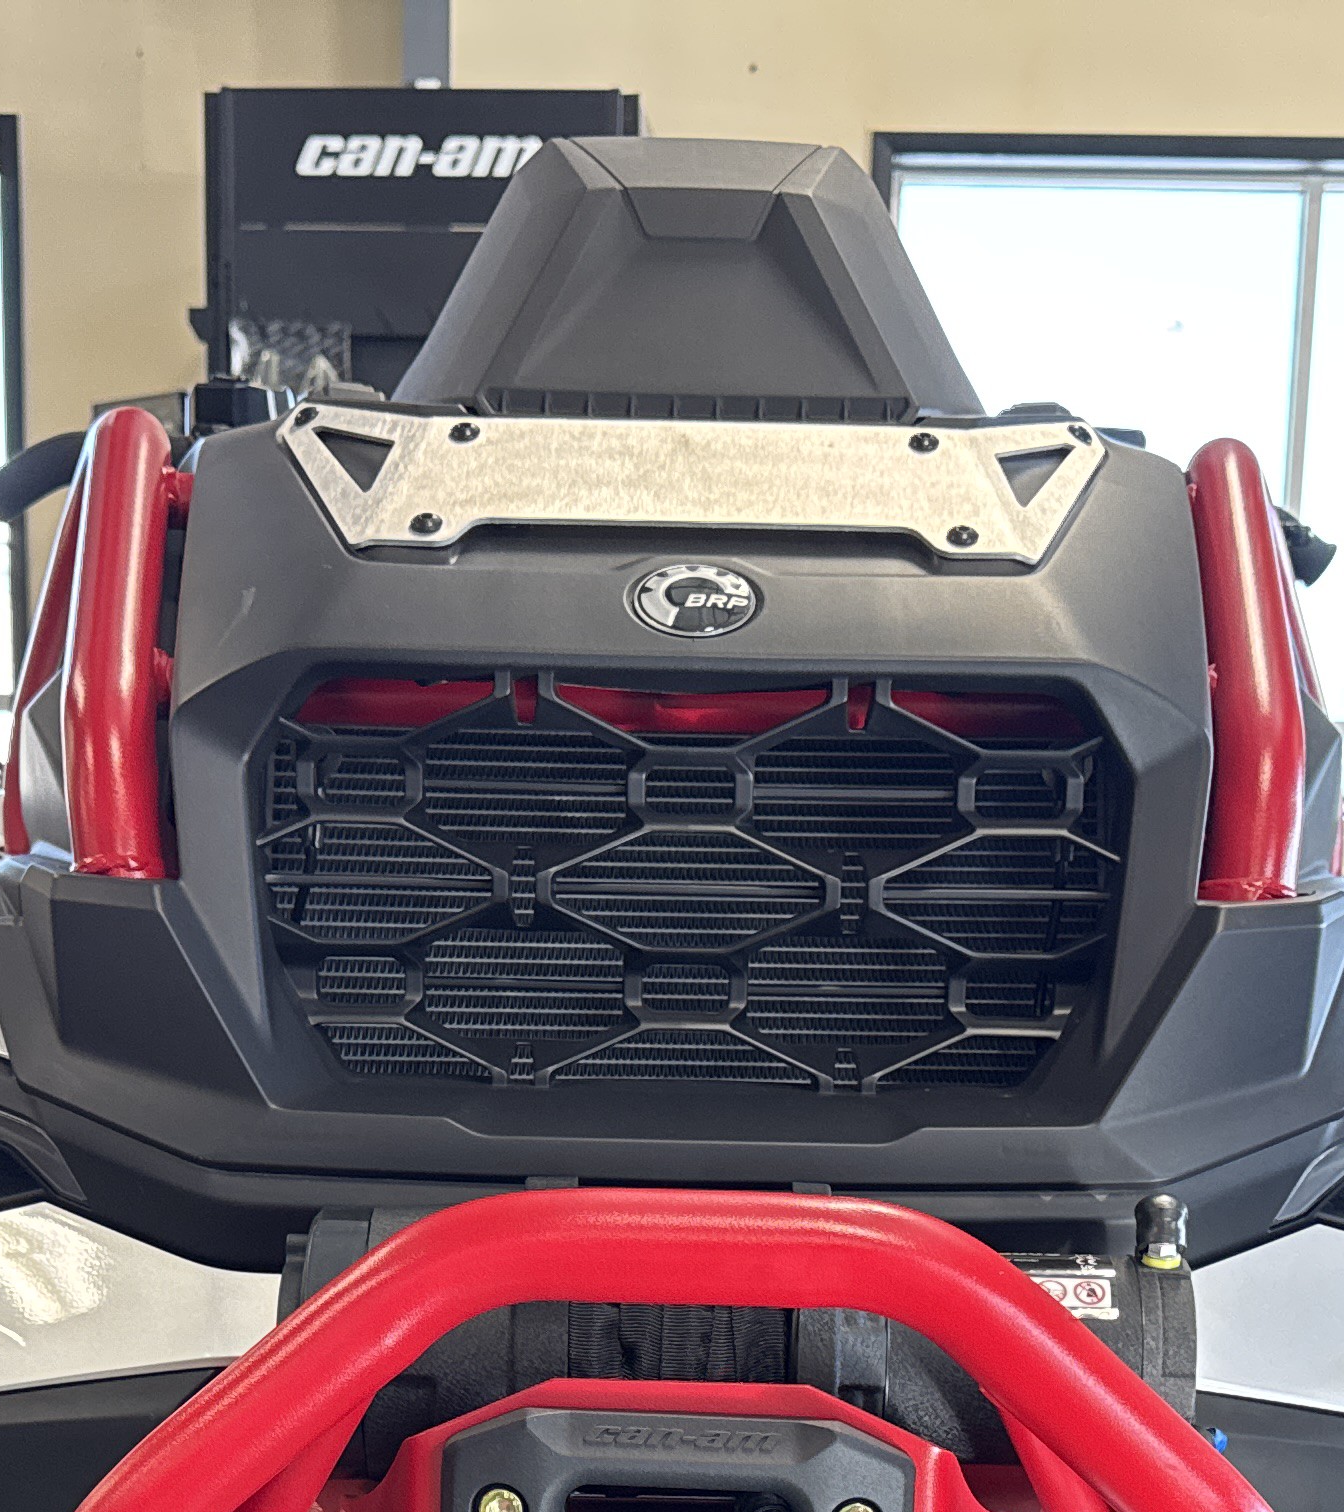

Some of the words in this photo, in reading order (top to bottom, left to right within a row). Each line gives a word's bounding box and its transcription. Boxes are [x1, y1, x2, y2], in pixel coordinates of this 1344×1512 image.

[295, 133, 544, 178] can-am
[684, 593, 749, 609] BRP
[583, 1425, 782, 1453] can-am
